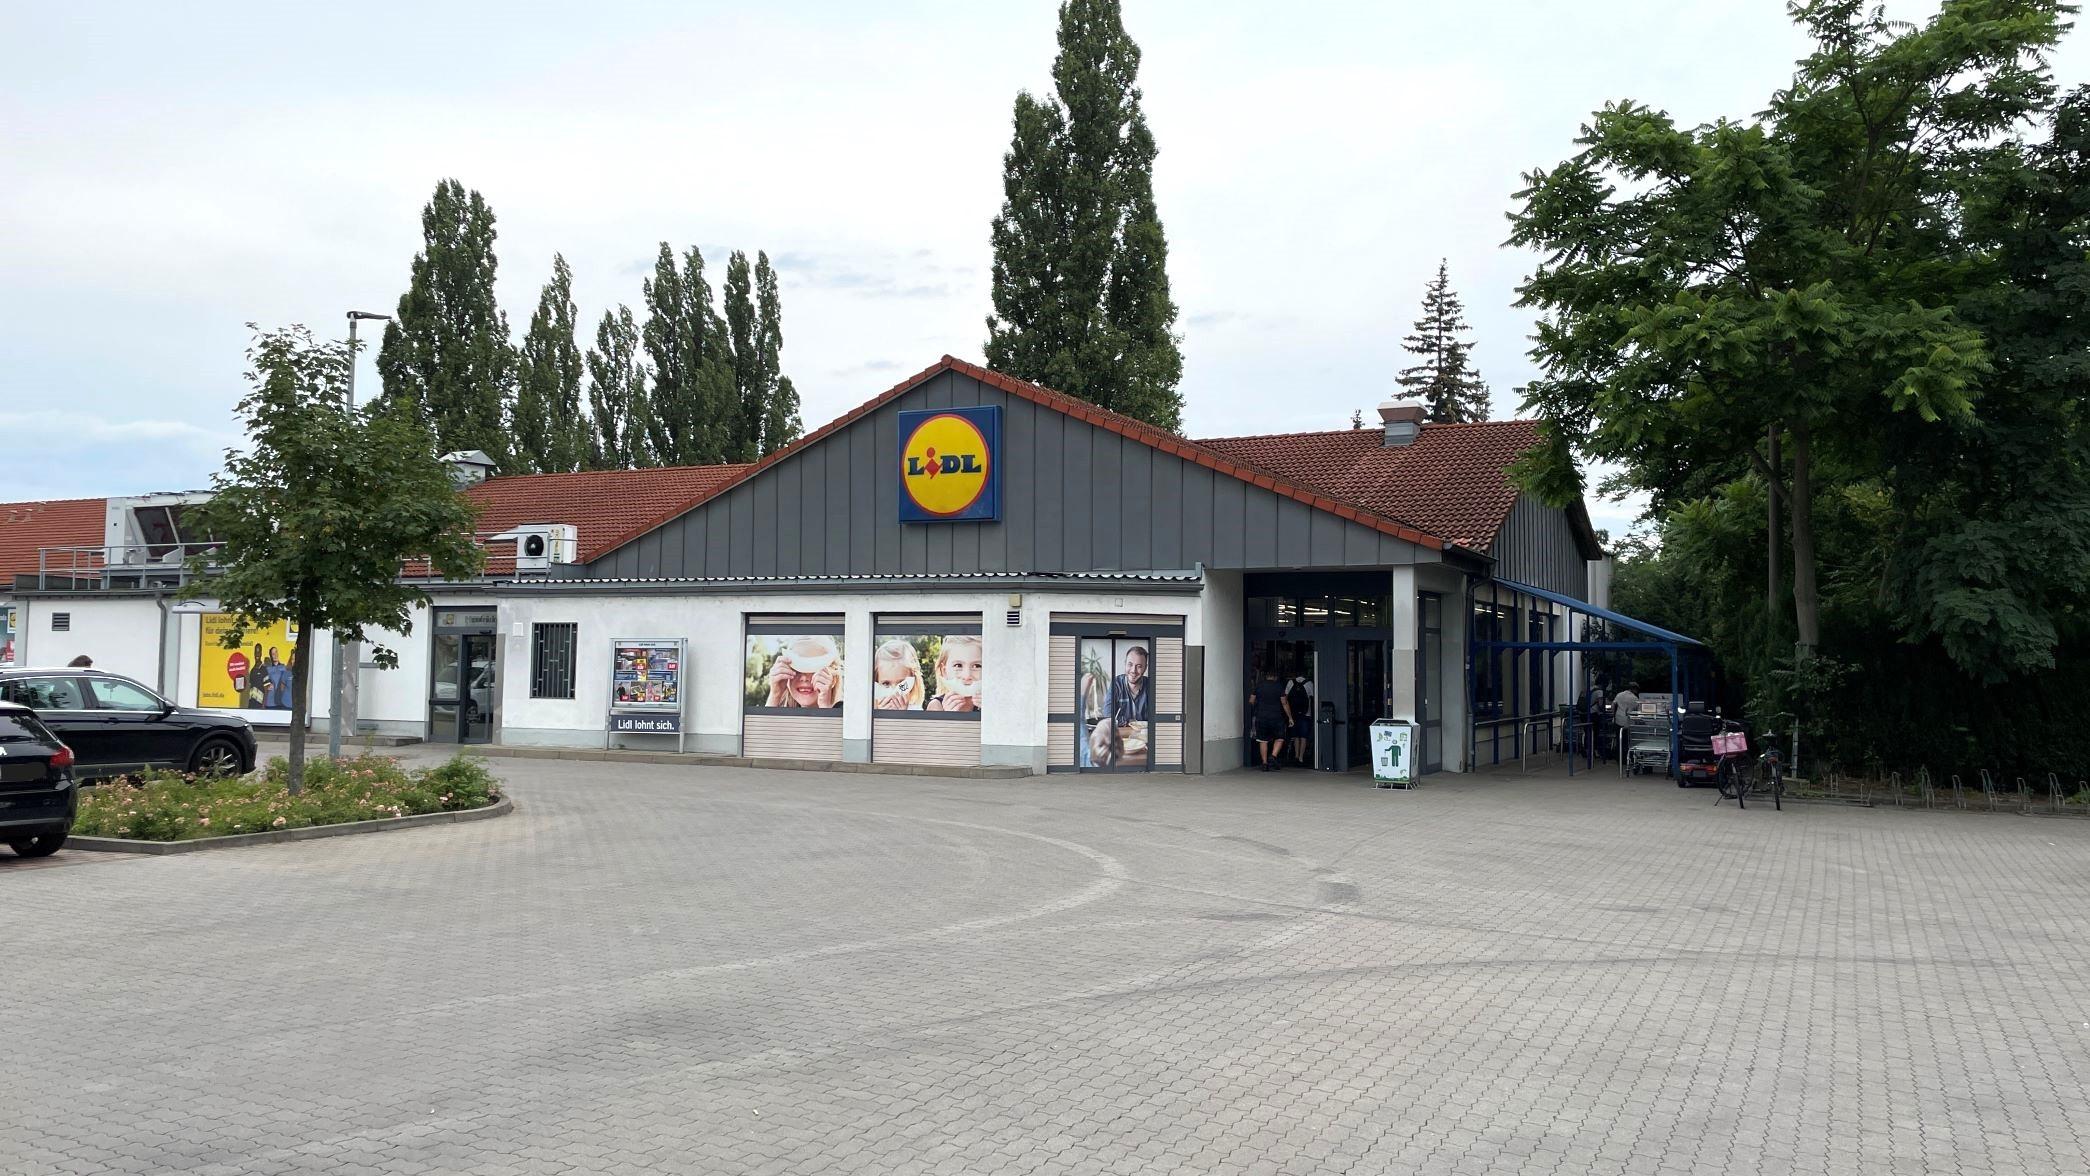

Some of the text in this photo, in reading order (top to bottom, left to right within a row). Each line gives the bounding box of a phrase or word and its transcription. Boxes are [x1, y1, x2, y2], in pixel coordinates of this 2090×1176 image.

[618, 719, 675, 730] Lidl lohnt sich.
